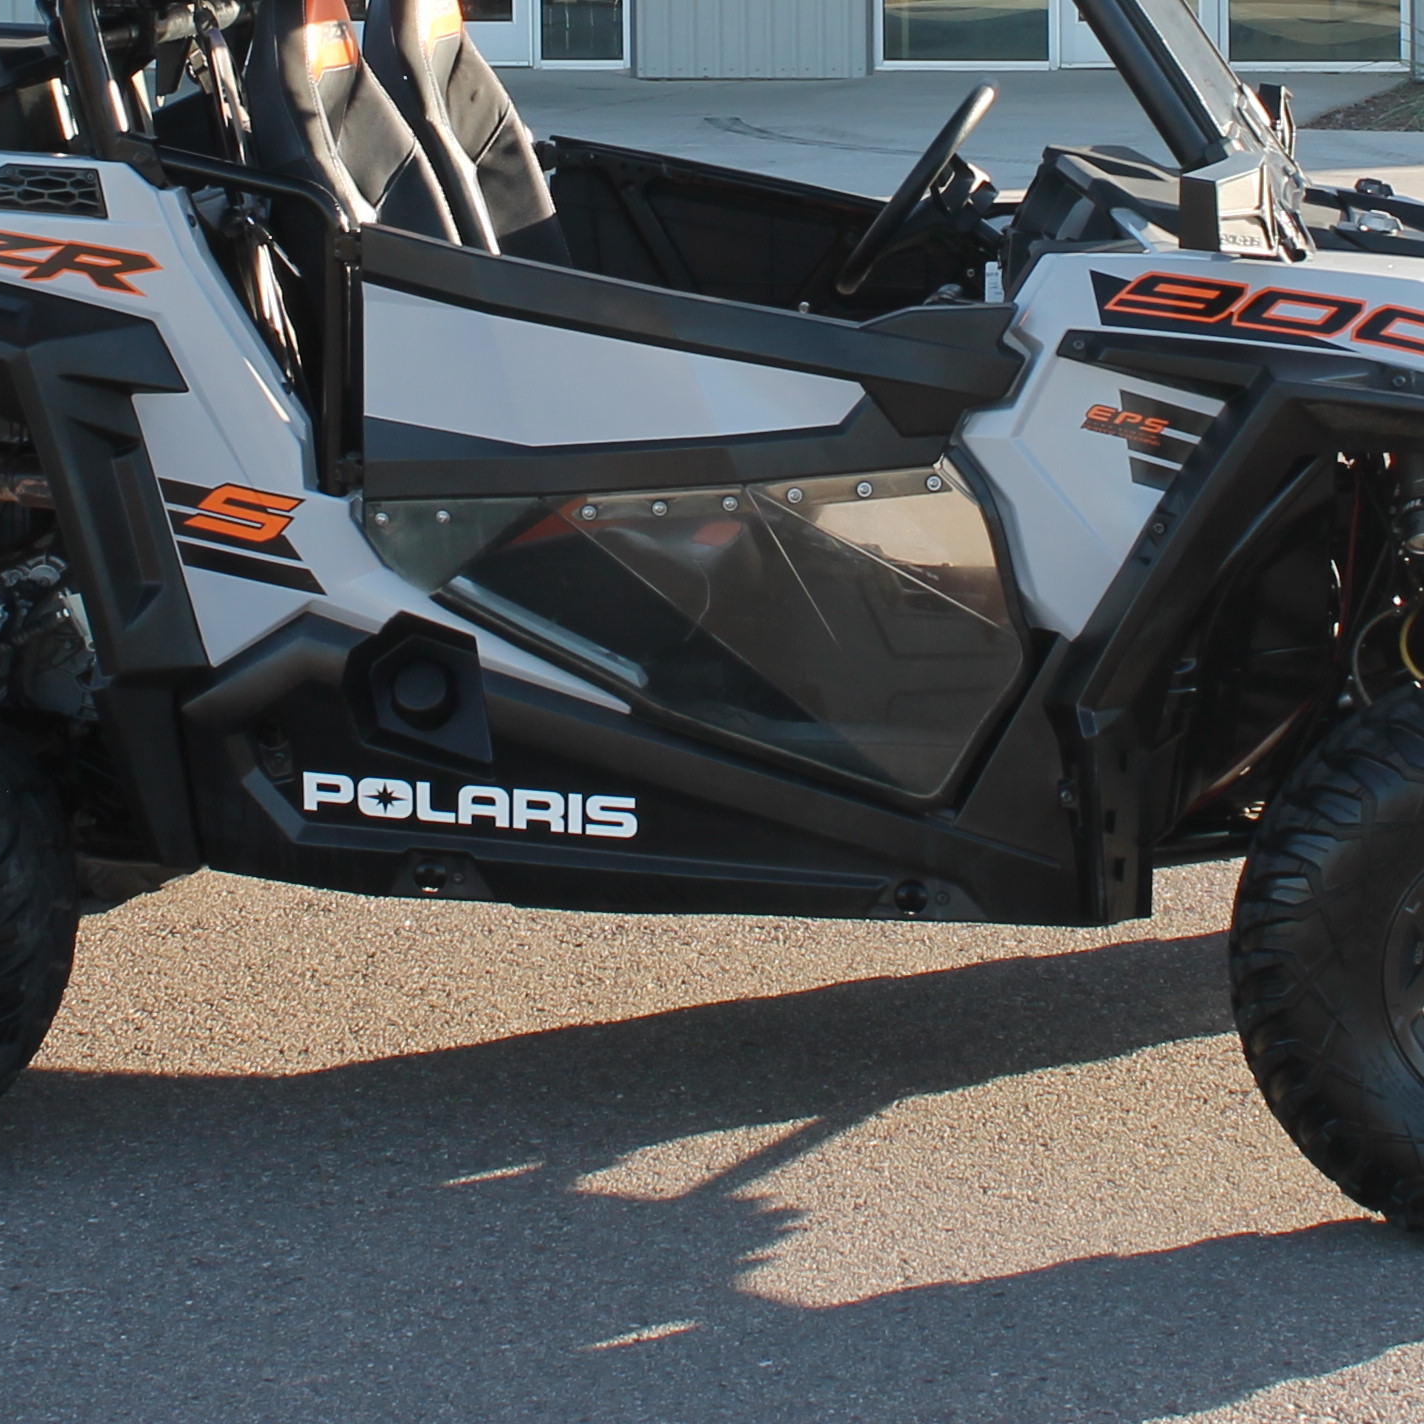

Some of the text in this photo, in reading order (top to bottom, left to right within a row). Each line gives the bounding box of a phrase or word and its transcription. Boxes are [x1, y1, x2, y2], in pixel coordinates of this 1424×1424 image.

[1085, 404, 1171, 434] EPS
[183, 482, 306, 543] S
[302, 770, 639, 839] POLARIS
